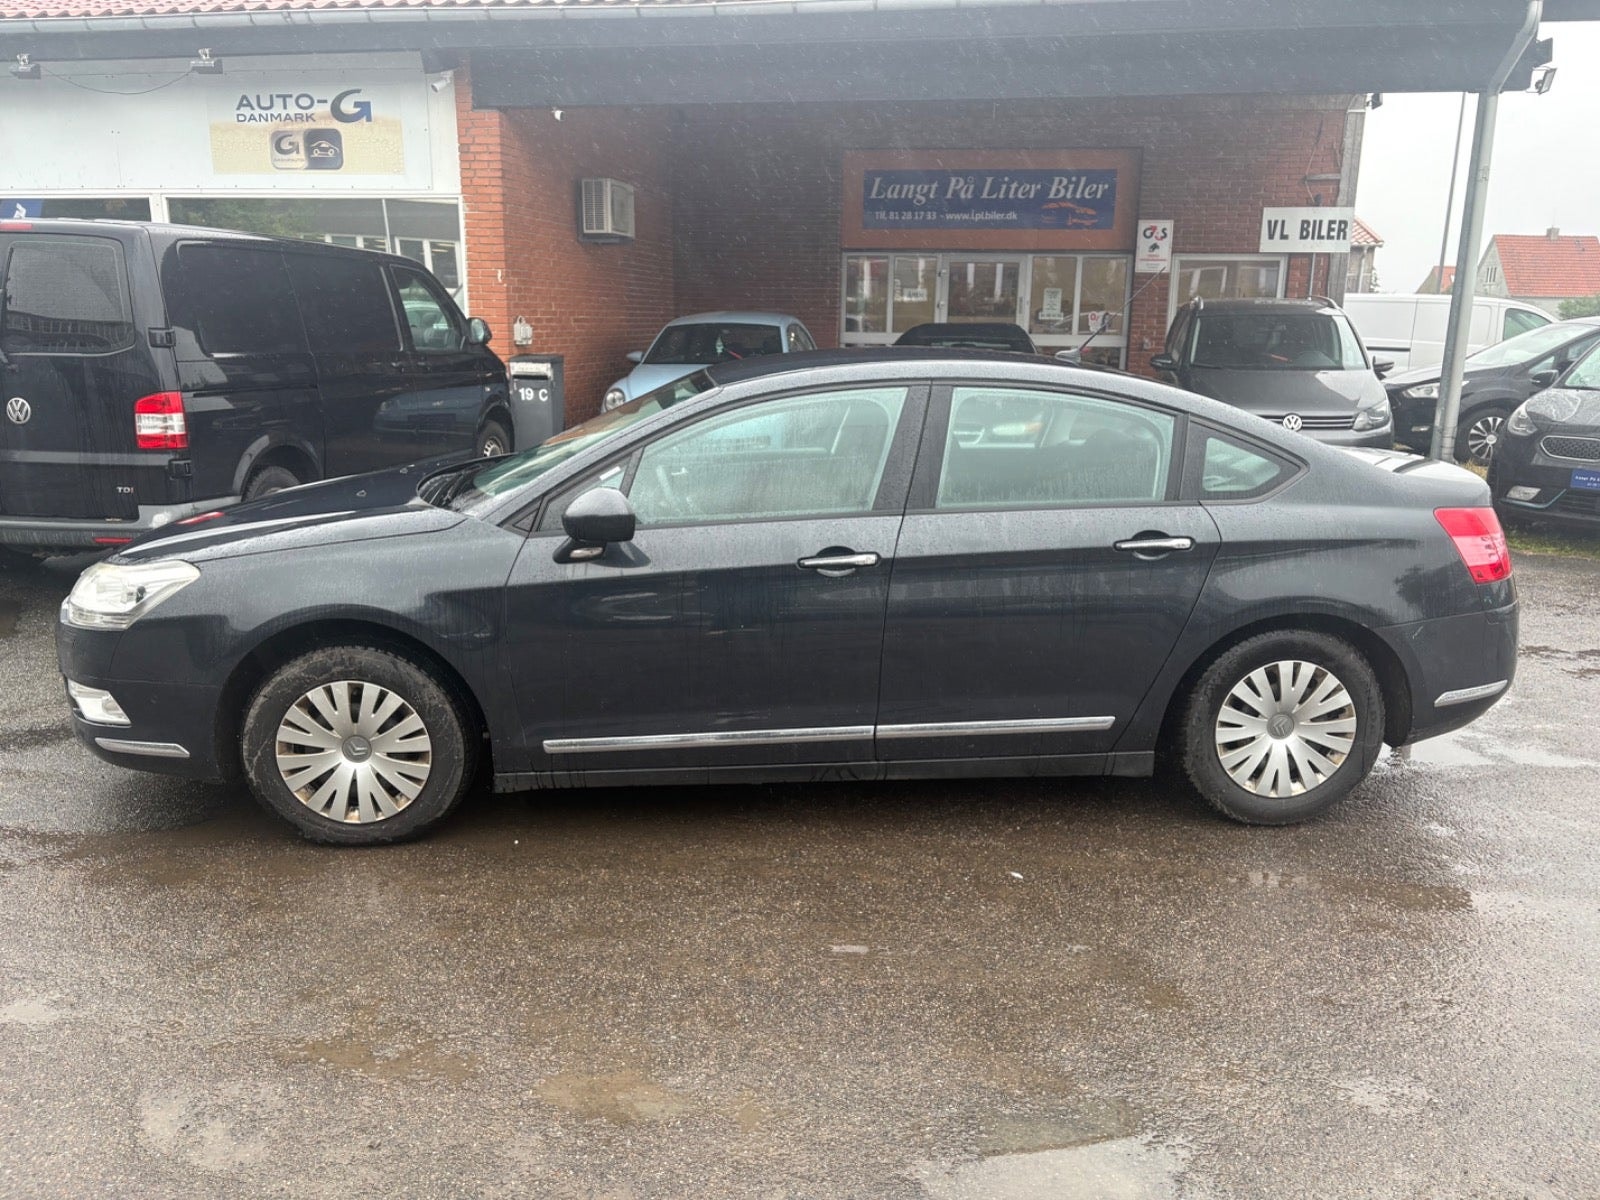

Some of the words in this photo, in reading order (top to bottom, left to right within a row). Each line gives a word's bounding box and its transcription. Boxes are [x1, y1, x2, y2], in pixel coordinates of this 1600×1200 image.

[236, 112, 317, 123] DANMARK
[870, 176, 938, 206] Langt
[945, 175, 976, 199] På
[980, 176, 1041, 199] Liter
[1047, 176, 1109, 199] Biler
[889, 211, 899, 220] 81
[914, 211, 924, 220] 17
[1267, 219, 1289, 241] VL
[1300, 219, 1349, 241] BILER
[518, 387, 534, 401] 19
[539, 388, 549, 402] C
[116, 486, 134, 494] TDI
